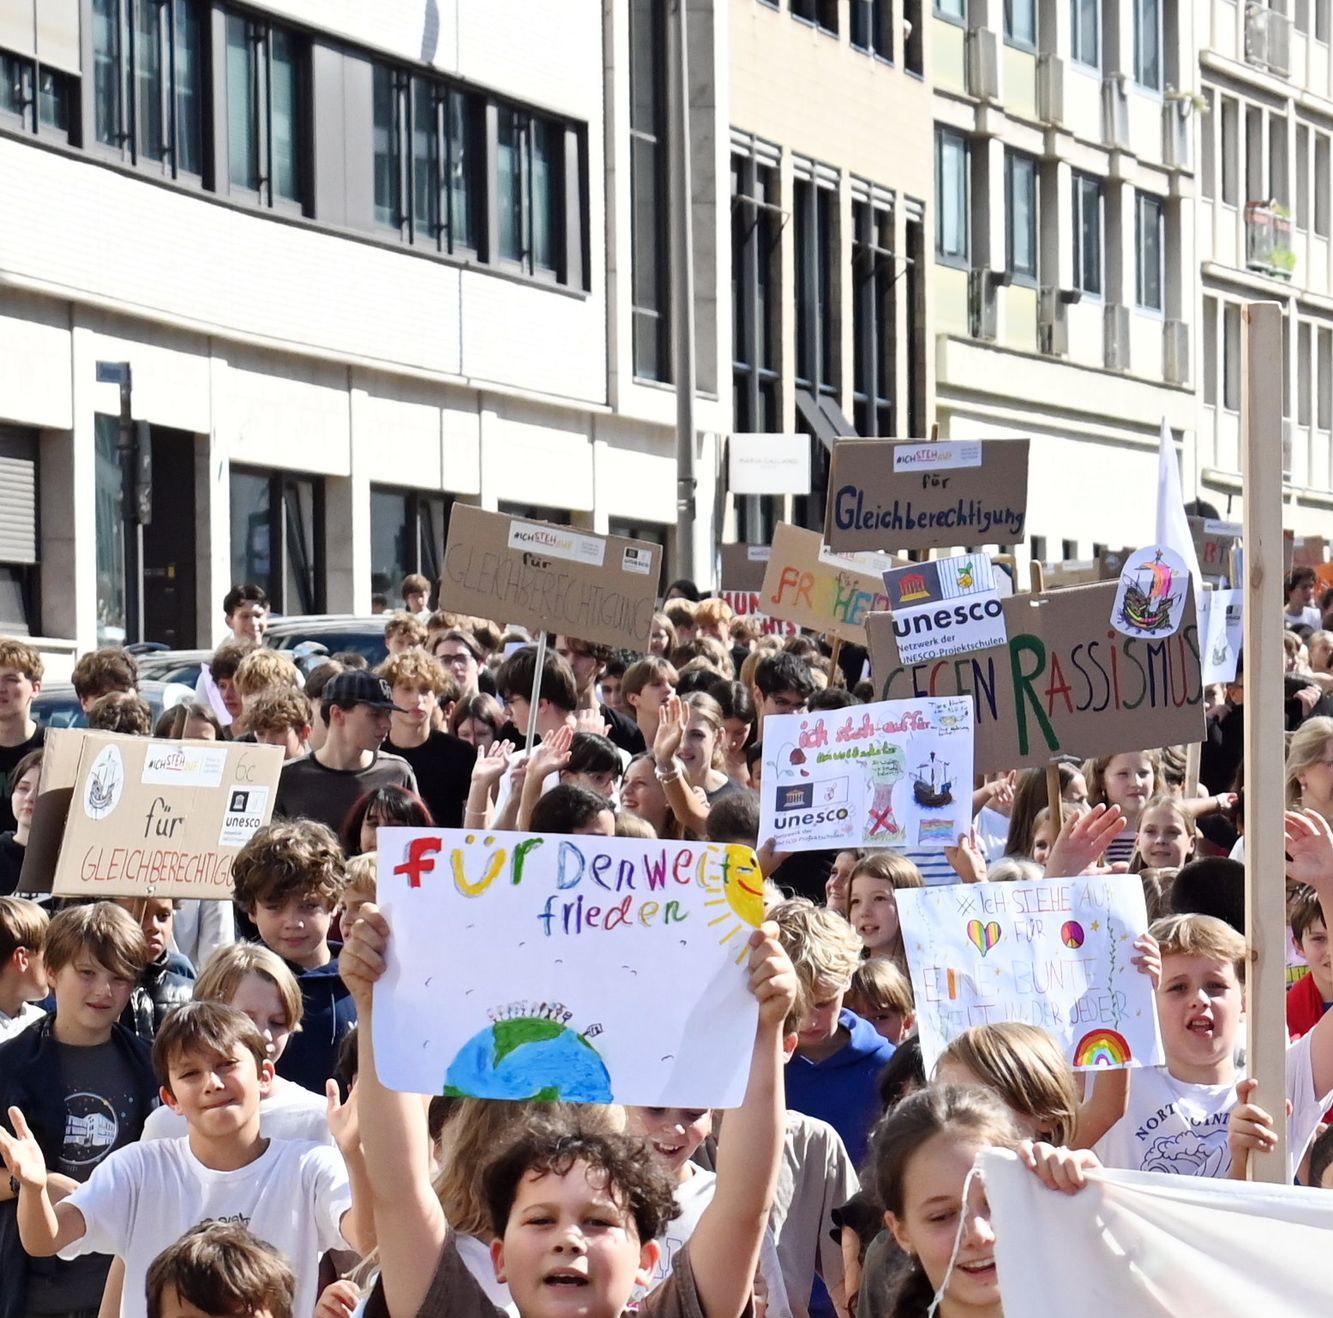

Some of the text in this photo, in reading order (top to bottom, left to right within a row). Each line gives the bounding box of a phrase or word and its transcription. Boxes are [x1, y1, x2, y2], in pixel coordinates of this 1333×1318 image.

[922, 473, 950, 489] für
[835, 485, 1025, 534] Gleichberechtigung
[523, 552, 552, 568] für
[892, 600, 1002, 637] unesco
[940, 635, 956, 644] der
[145, 797, 184, 838] für
[226, 817, 261, 828] unesco
[774, 808, 848, 829] unesco
[81, 847, 235, 887] GLEICHBERECHTIGU
[1011, 886, 1072, 913] STEHE
[1013, 918, 1047, 943] FÜR
[924, 958, 1099, 1003] EINE BUNTE
[1071, 991, 1131, 1025] JEDER
